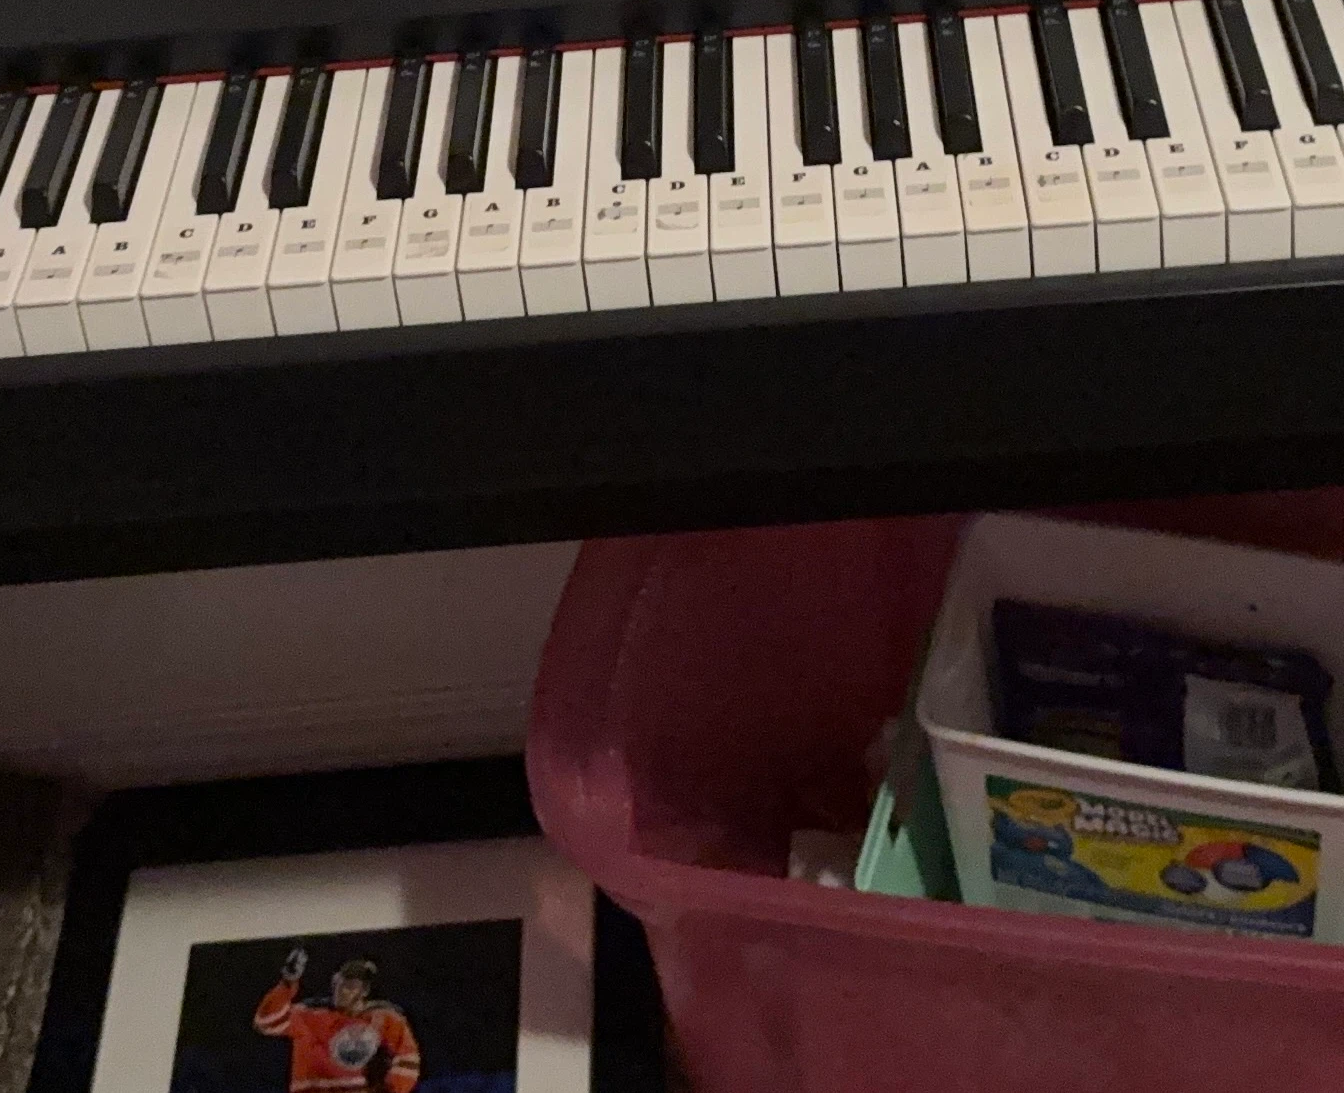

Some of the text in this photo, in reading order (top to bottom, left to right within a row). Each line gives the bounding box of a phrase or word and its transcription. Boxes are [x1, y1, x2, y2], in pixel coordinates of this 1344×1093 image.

[51, 245, 65, 255] A
[114, 241, 128, 251] B
[179, 228, 193, 238] C
[237, 223, 253, 232] D
[301, 219, 315, 229] E
[362, 215, 376, 225] F
[422, 208, 437, 218] G
[485, 202, 498, 211] A
[546, 197, 560, 207] B
[611, 184, 625, 193] C
[670, 181, 685, 190] D
[731, 176, 744, 185] E
[792, 172, 805, 182] F
[853, 166, 868, 175] G
[916, 161, 929, 171] A
[979, 156, 992, 165] B
[1045, 151, 1058, 160] C
[1104, 148, 1119, 157] D
[1169, 143, 1184, 153] E
[1234, 140, 1247, 149] F
